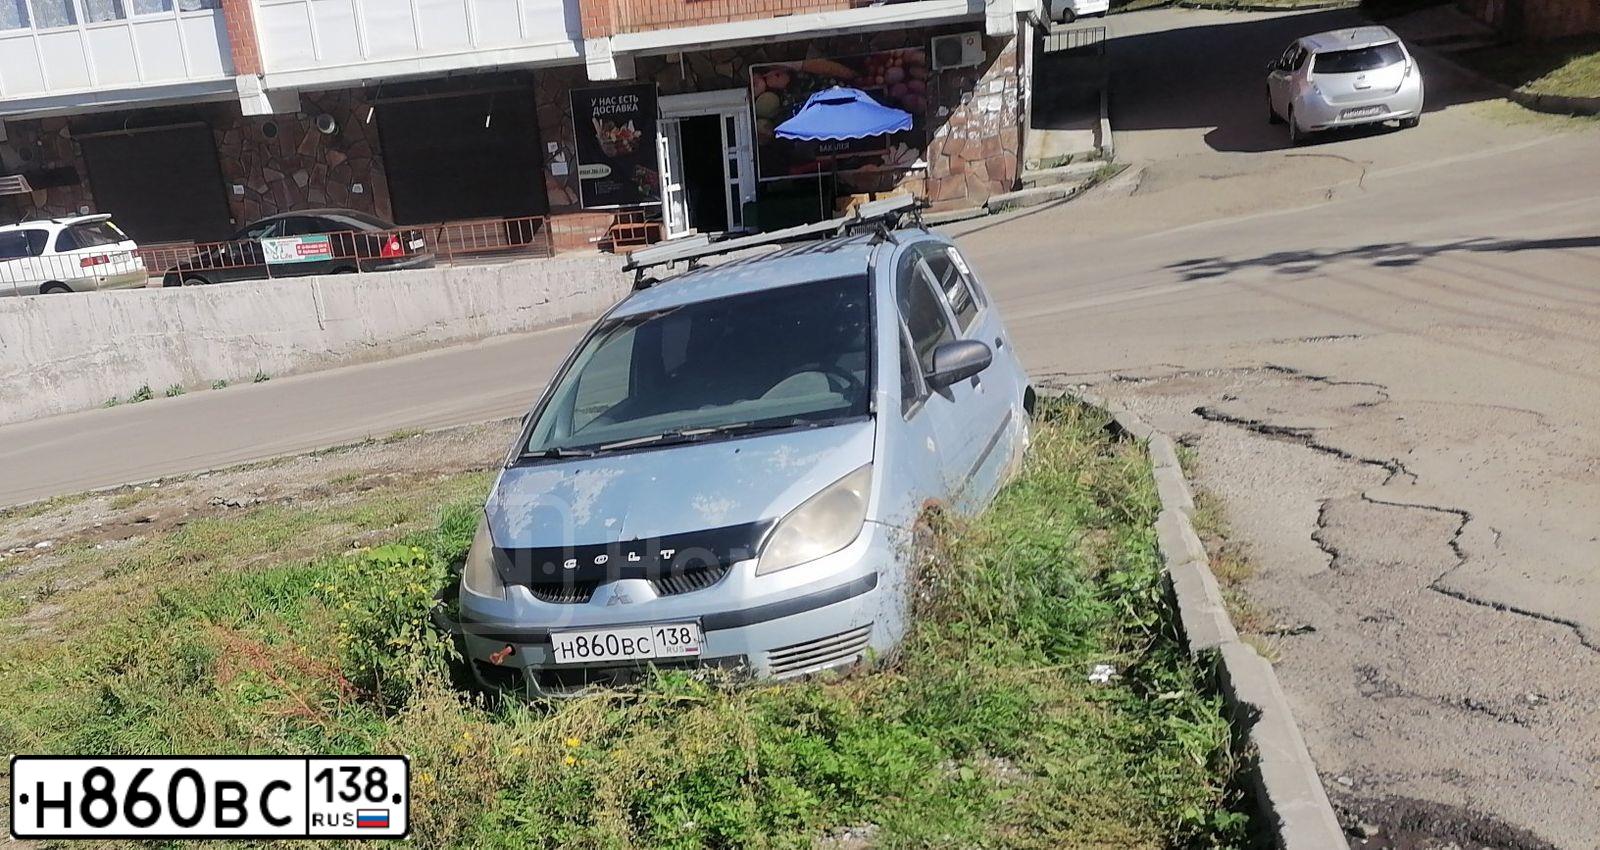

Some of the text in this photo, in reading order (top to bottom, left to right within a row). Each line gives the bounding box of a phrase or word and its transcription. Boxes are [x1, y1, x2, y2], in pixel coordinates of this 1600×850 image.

[591, 95, 638, 107] У НАС ЕСТЬ
[592, 103, 639, 117] ДОСТАВКА
[561, 627, 691, 659] Н860ВС 138
[666, 645, 685, 654] RUS
